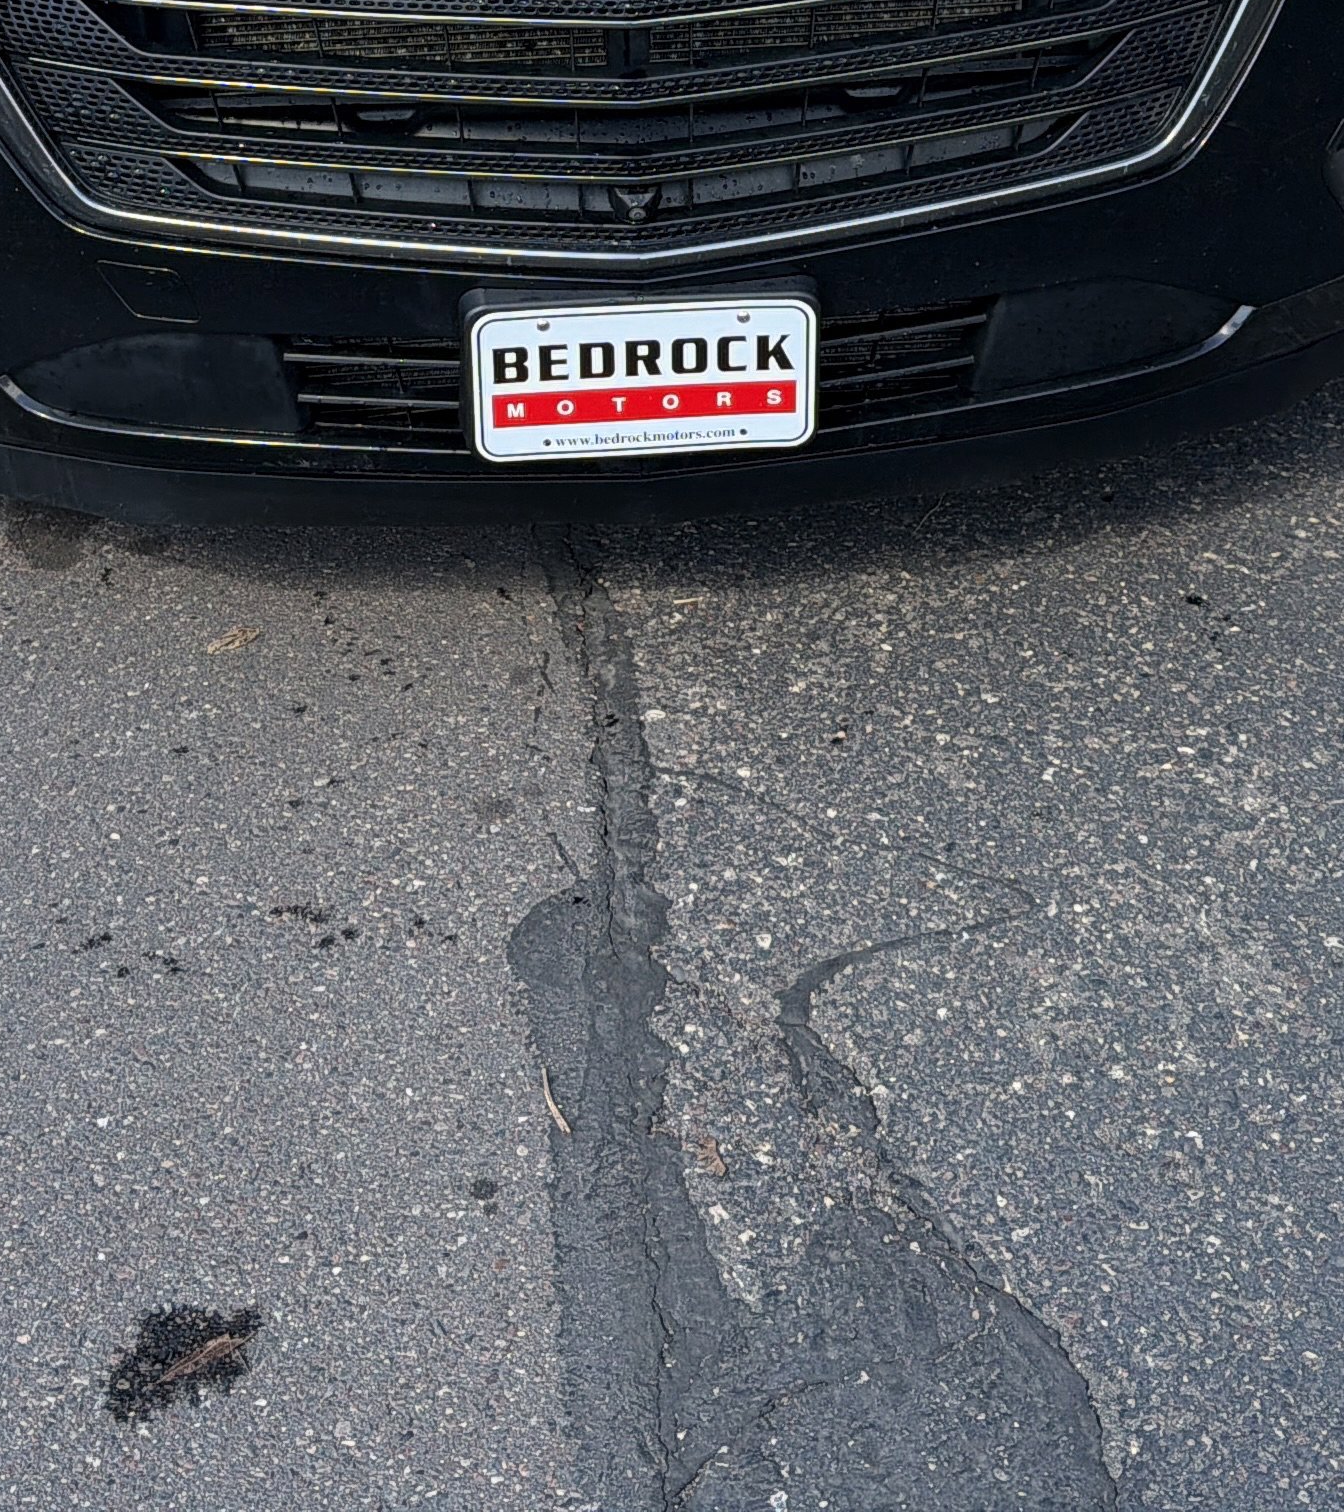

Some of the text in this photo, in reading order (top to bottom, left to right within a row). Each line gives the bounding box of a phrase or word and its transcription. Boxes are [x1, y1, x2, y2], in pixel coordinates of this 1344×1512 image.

[492, 334, 795, 385] BEDROCK
[506, 389, 783, 419] MOTORS
[555, 428, 736, 448] www.bedrockmotors.com
